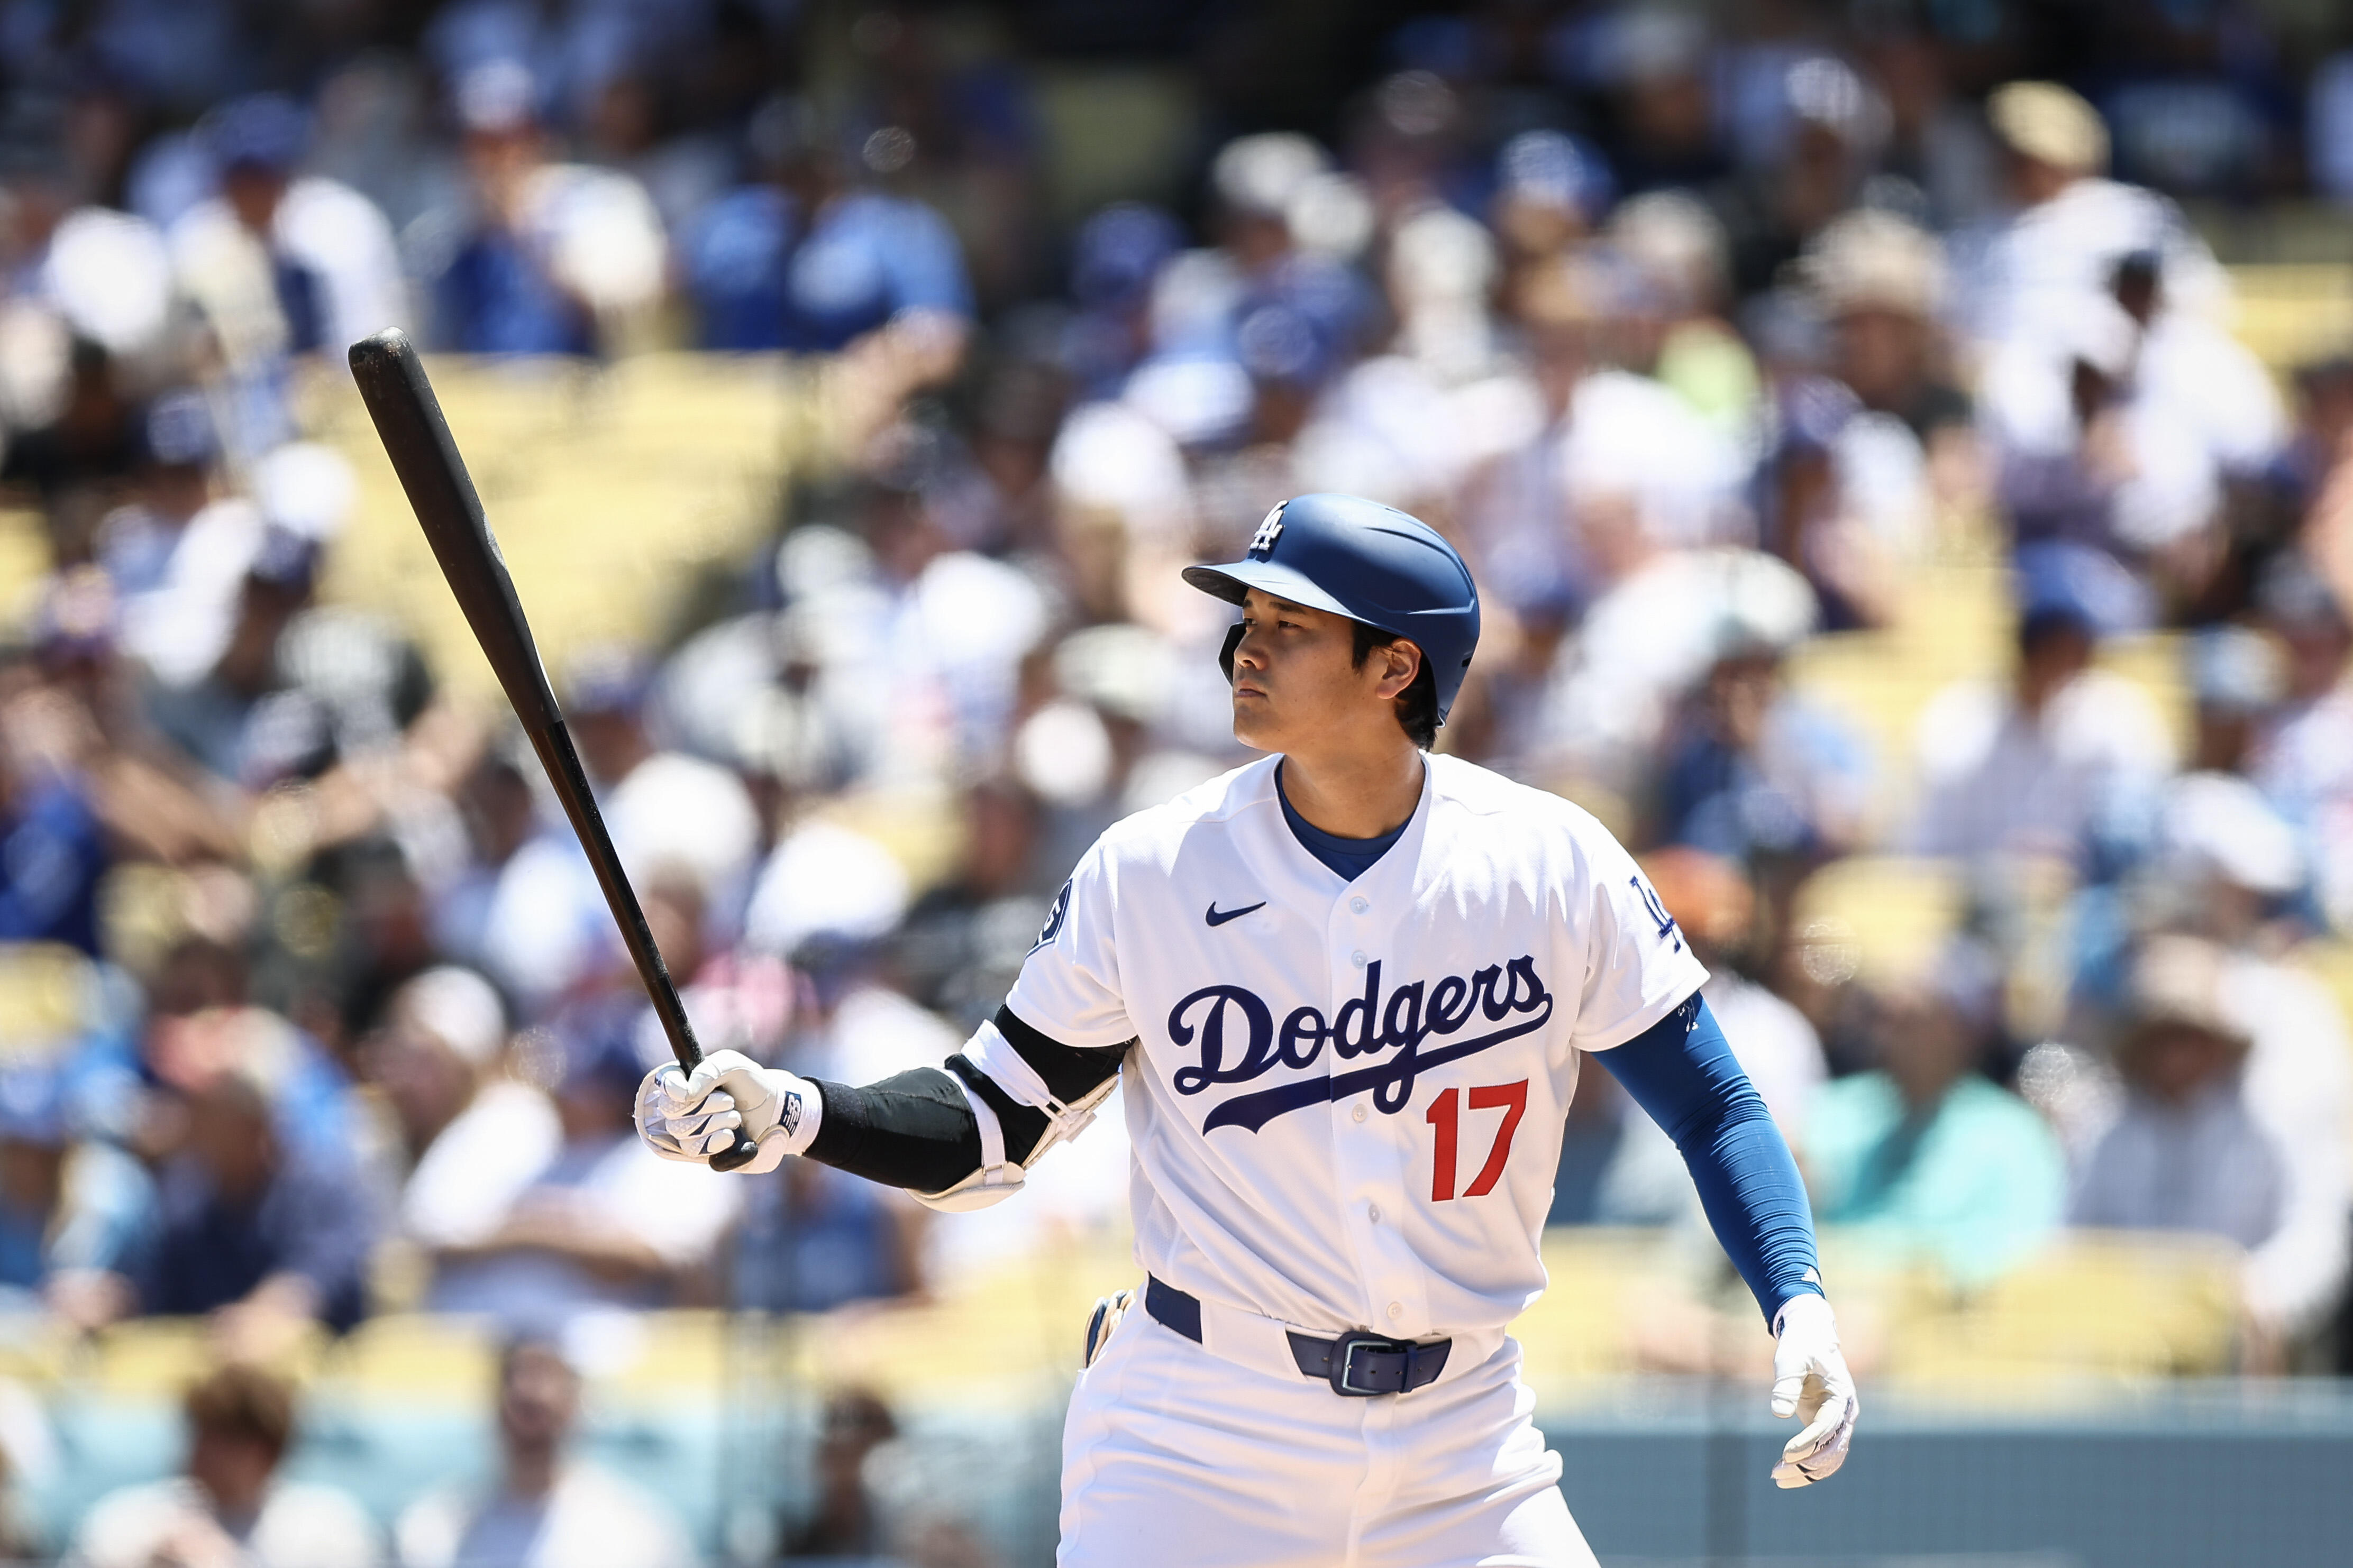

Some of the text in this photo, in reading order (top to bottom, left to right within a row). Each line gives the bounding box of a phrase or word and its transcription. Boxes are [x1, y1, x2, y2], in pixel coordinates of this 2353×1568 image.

[1250, 500, 1288, 551] LA
[1168, 955, 1554, 1115] Dodgers
[1426, 1078, 1529, 1203] 17
